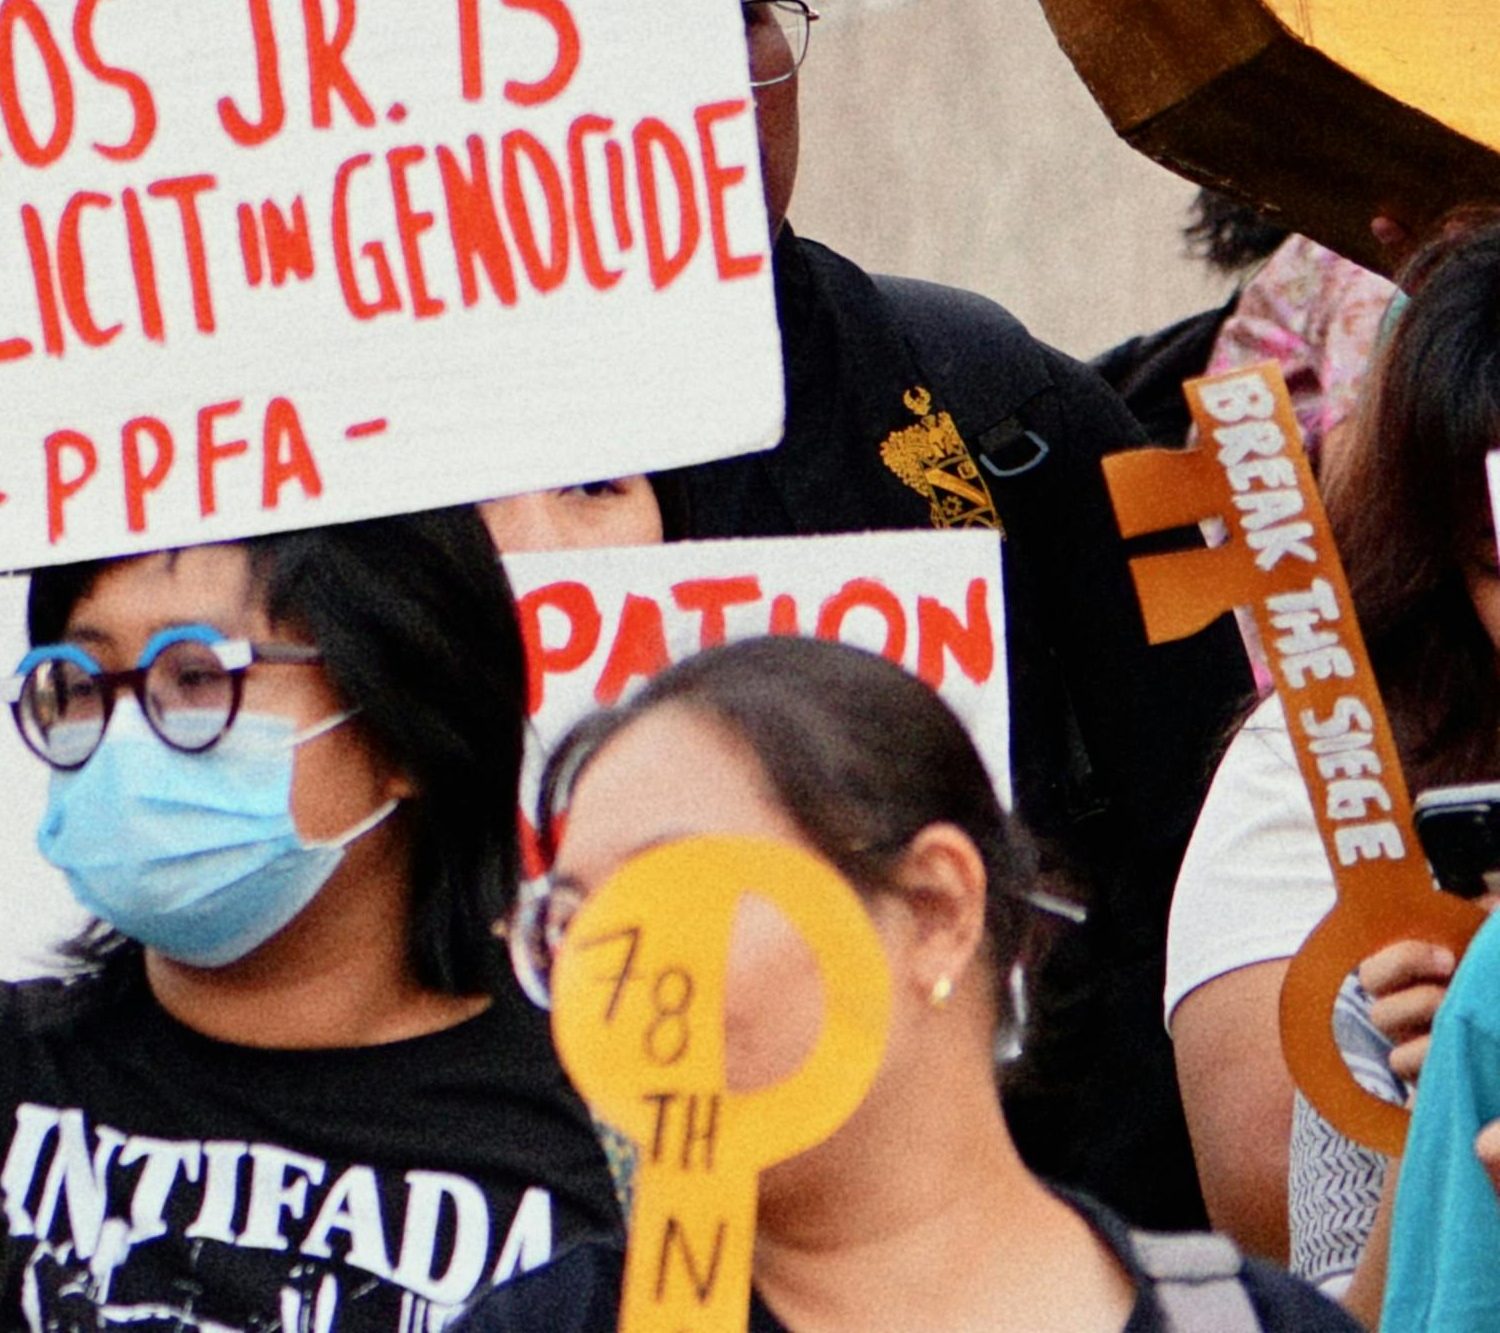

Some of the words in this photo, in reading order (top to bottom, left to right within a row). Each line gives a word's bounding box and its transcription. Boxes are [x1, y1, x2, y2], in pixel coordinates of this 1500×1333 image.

[331, 99, 765, 321] GENOCIDE
[1199, 373, 1317, 572] BREAK
[1264, 577, 1356, 689] THE
[1299, 695, 1406, 868] SIEGE
[0, 1102, 554, 1306] INTIFADA
